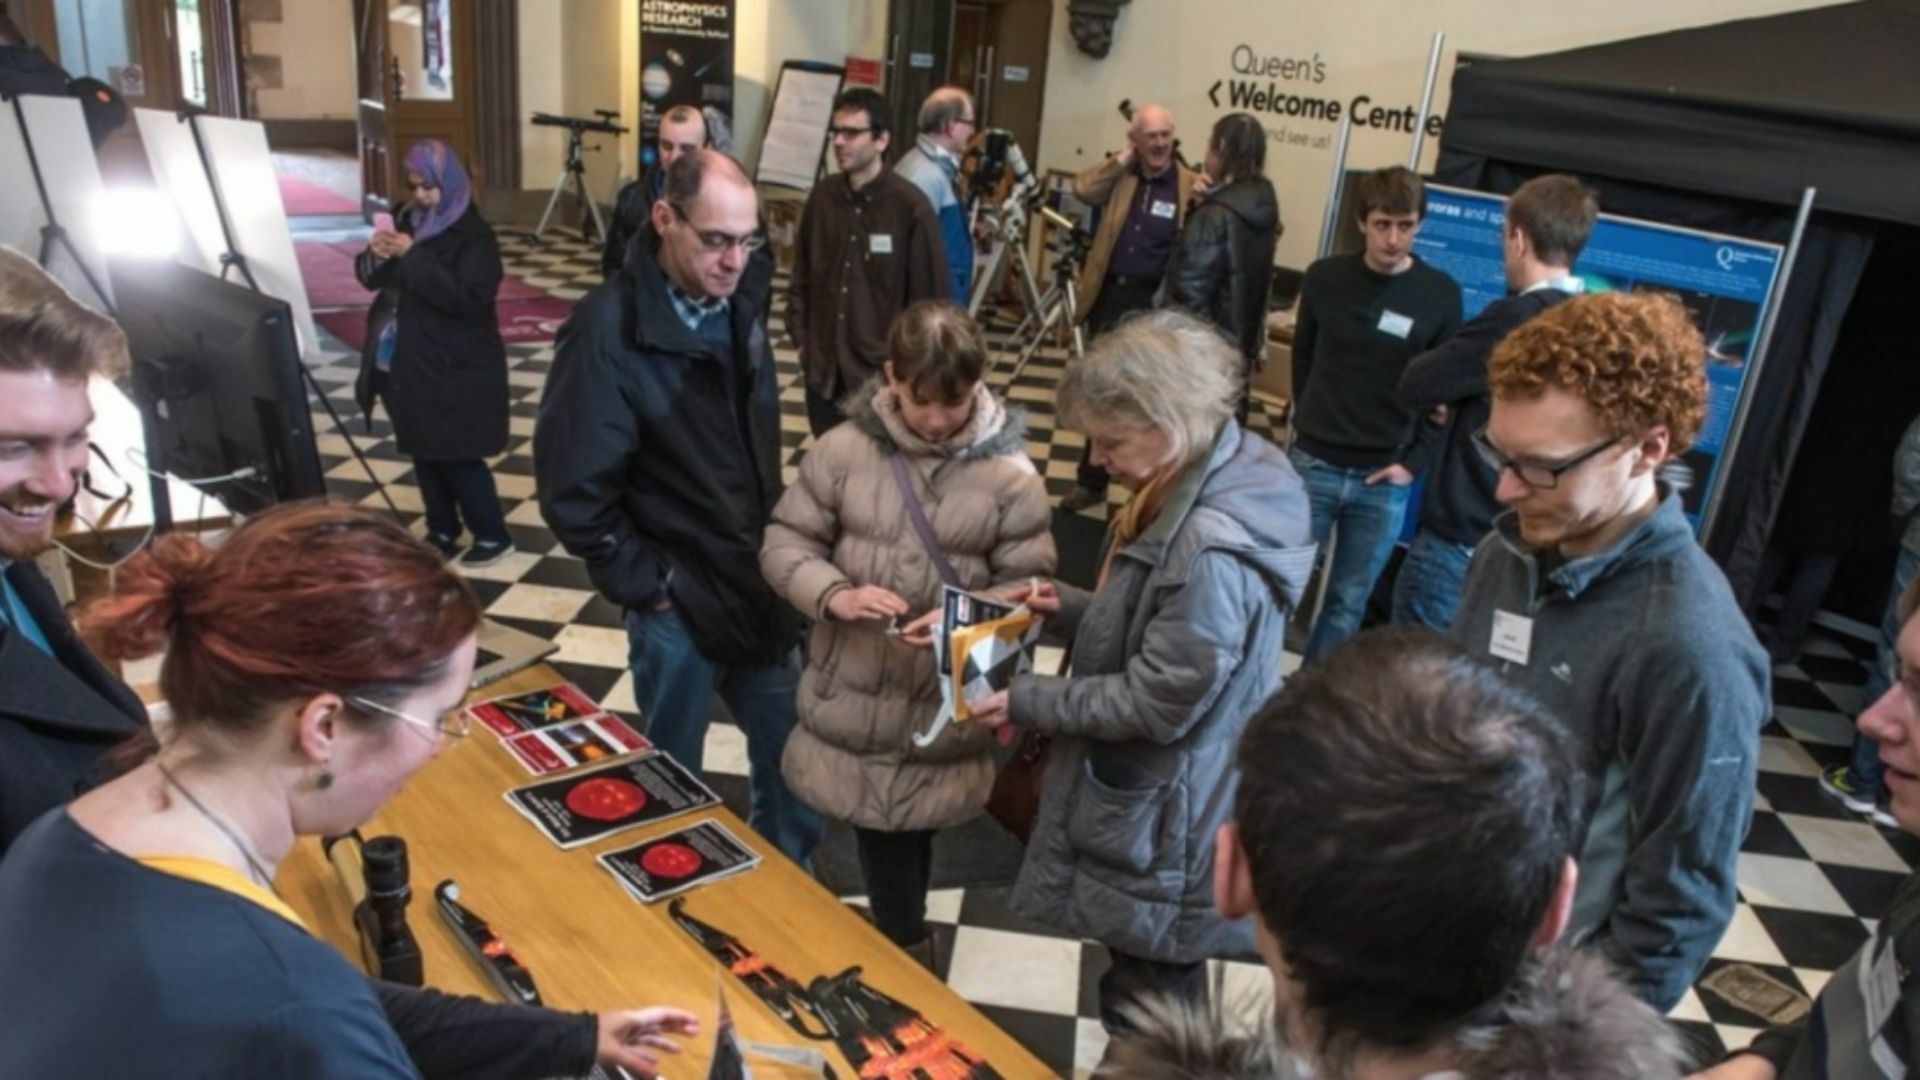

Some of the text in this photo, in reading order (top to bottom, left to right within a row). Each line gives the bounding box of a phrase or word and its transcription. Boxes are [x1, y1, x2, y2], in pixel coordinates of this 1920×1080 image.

[642, 1, 728, 18] ASTROPHYSICS
[642, 13, 702, 27] RESEARCH
[1231, 44, 1326, 84] Queen's
[1229, 79, 1443, 137] Welcome Cente
